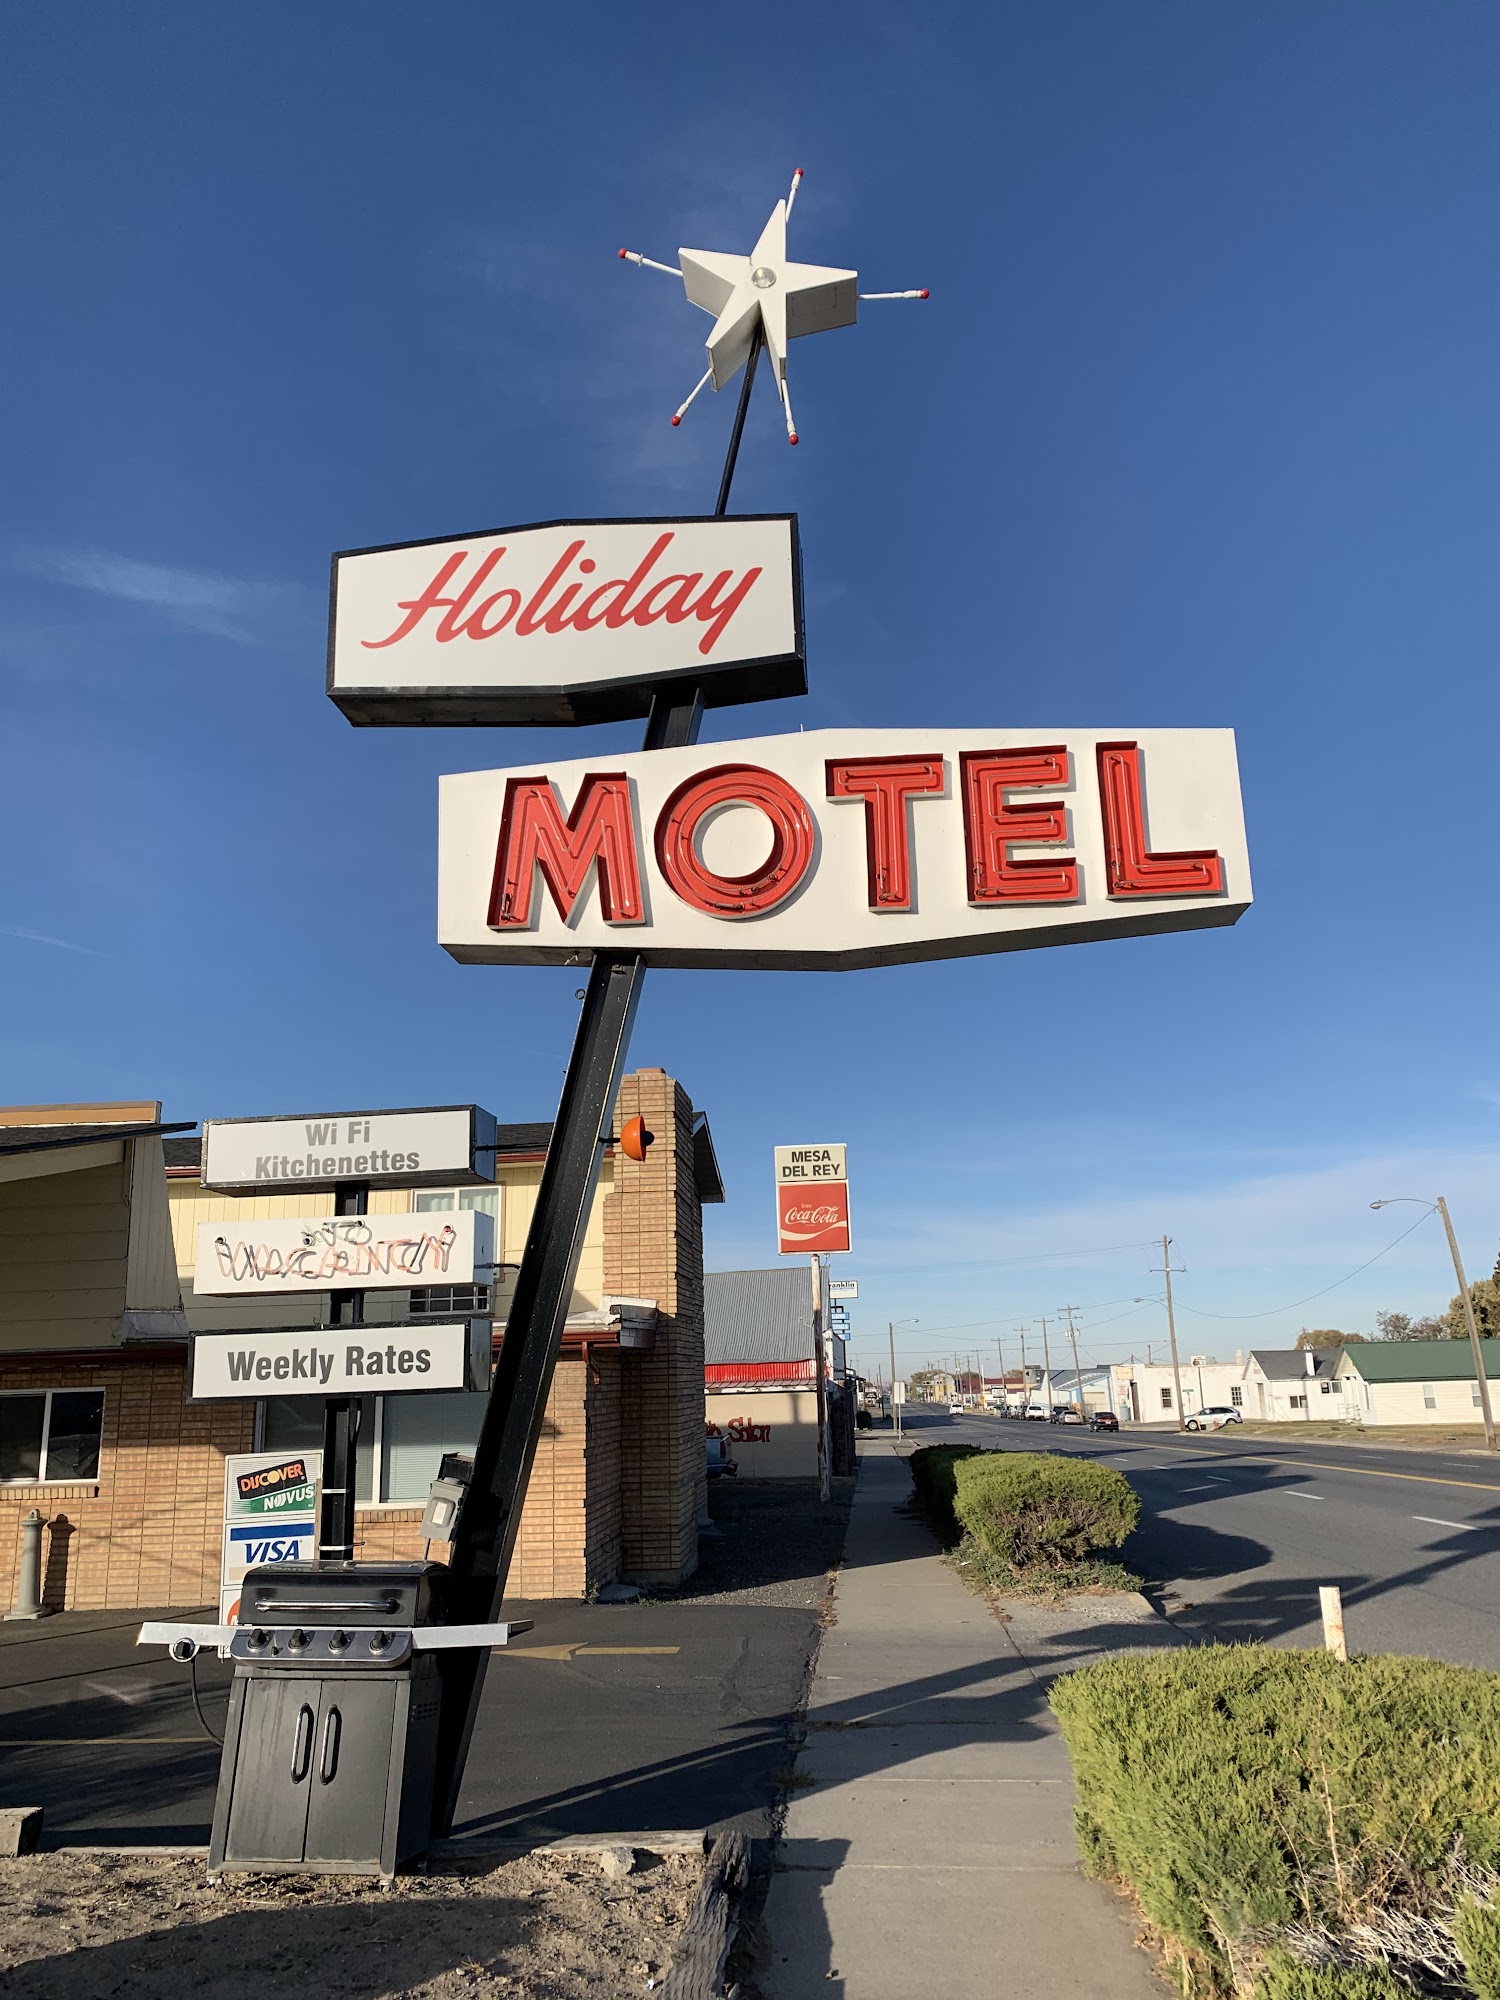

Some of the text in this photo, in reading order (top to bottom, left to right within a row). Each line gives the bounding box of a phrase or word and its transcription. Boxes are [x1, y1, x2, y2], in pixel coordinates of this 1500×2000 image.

[360, 531, 763, 655] Holiday
[487, 741, 1224, 931] MOTEL
[305, 1121, 370, 1146] Wi Fi
[255, 1150, 420, 1179] Kitchenettes
[782, 1163, 840, 1177] DEL REY
[791, 1150, 831, 1163] MESA
[785, 1206, 840, 1225] Coca-Cola
[214, 1226, 456, 1281] VACANCY
[227, 1345, 431, 1384] Weekly Rates
[727, 1416, 772, 1443] Salon
[240, 1463, 303, 1492] DISCOVER
[263, 1485, 314, 1511] NOVUS
[245, 1540, 300, 1564] VISA
